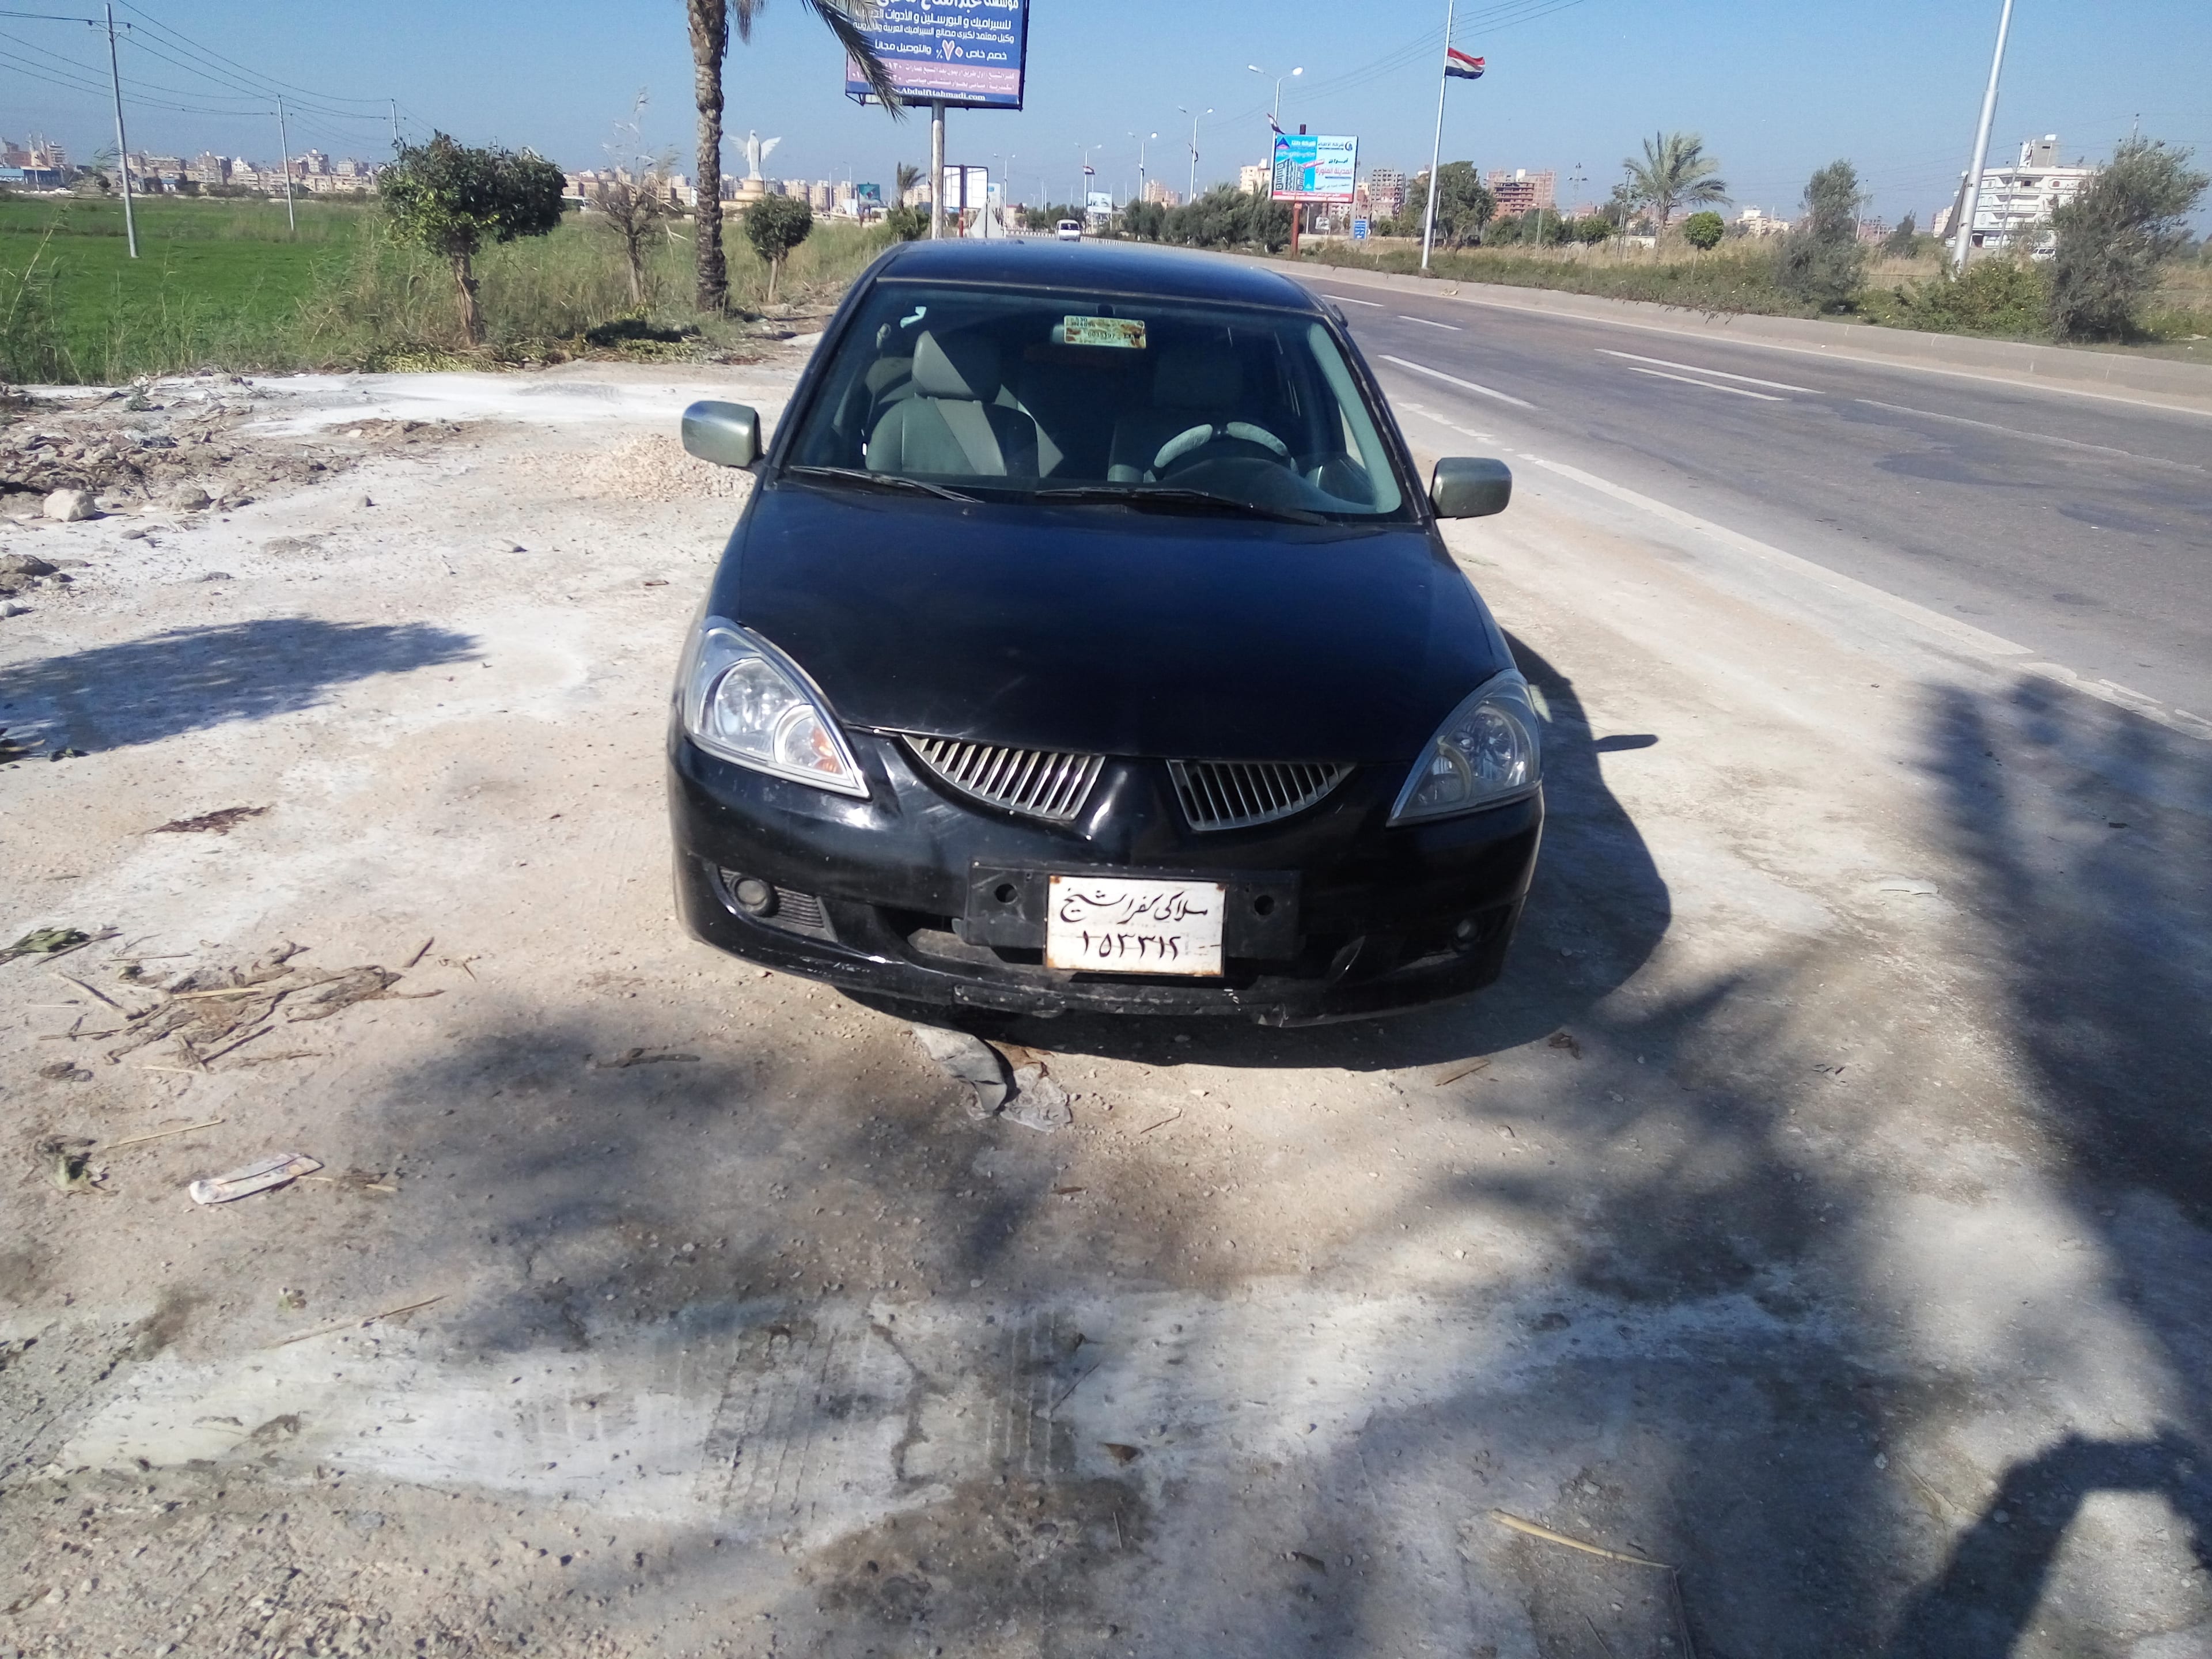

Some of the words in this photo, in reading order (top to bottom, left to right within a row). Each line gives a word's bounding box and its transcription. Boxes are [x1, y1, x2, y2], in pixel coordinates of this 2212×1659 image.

[885, 9, 913, 22] الأدوات
[921, 12, 963, 26] البورسلين
[882, 22, 903, 33] العربية
[970, 17, 1012, 31] للسيراميك
[904, 25, 934, 36] السيراميك
[935, 28, 956, 38] مصانع
[975, 32, 997, 41] معتمد
[997, 33, 1014, 44] وكيل
[896, 42, 932, 55] والتوصيل
[965, 49, 986, 59] خاص
[986, 51, 1007, 61] خصم
